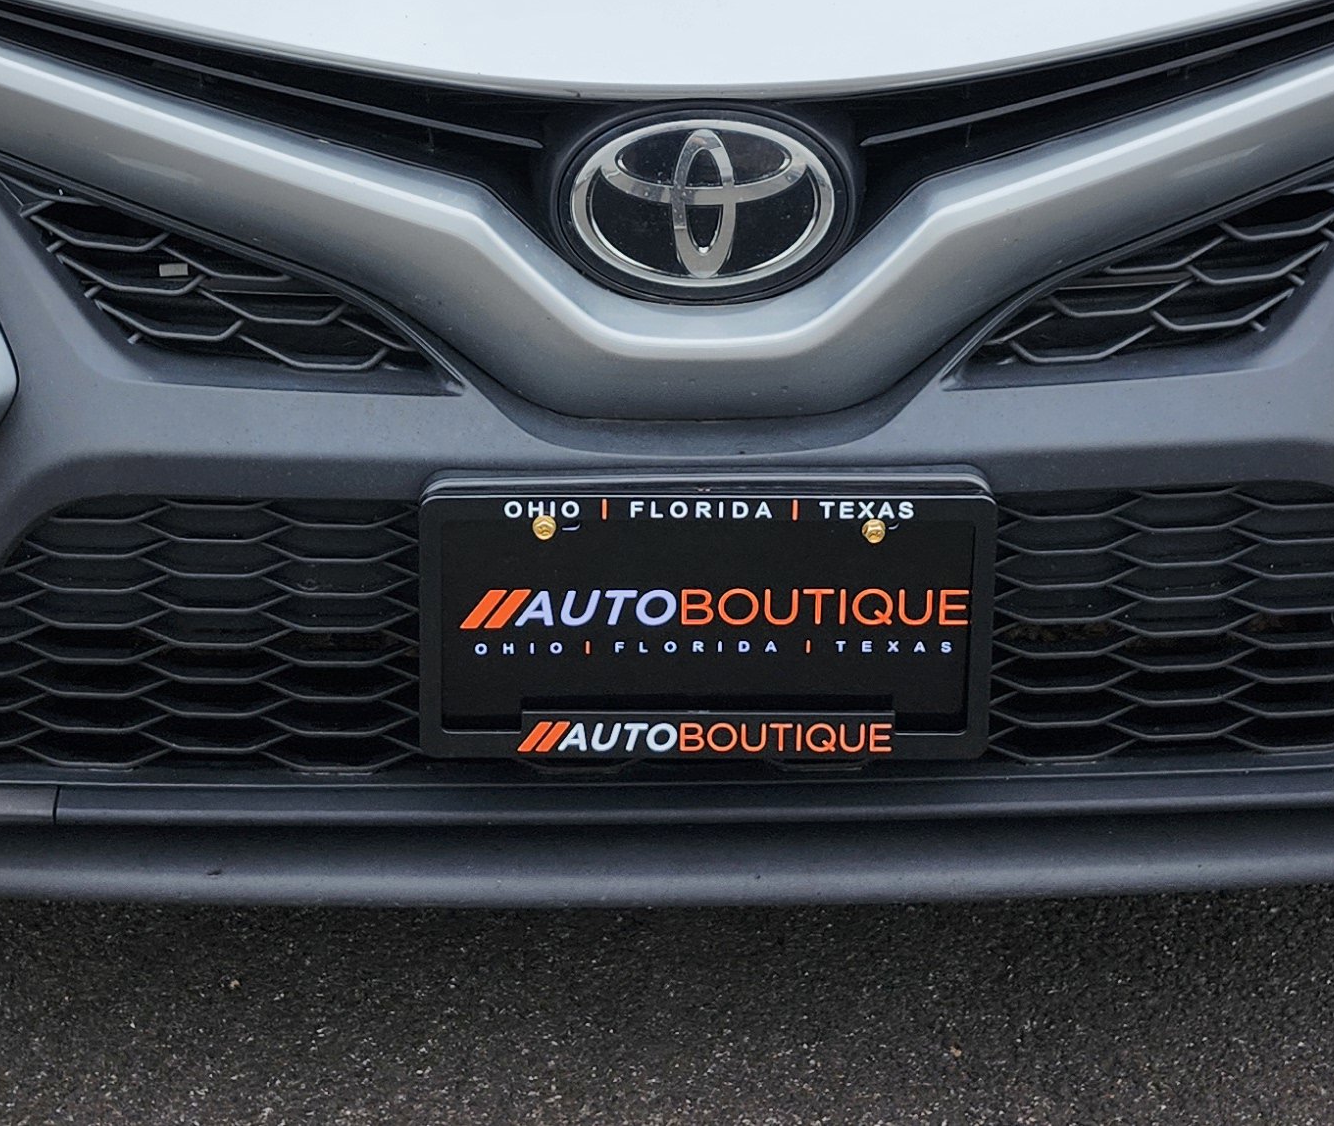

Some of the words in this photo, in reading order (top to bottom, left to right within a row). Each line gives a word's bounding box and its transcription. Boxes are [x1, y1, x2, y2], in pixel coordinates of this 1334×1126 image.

[503, 501, 581, 519] OHIO
[629, 501, 772, 519] FLORIDA
[819, 501, 915, 520] TEXAS
[515, 588, 970, 627] AUTOBOUTIQUE
[474, 641, 563, 655] OHIO
[614, 641, 778, 654] FLORIDA
[836, 640, 953, 654] TEXAS
[558, 721, 893, 753] AUTOBOUTIQUE
